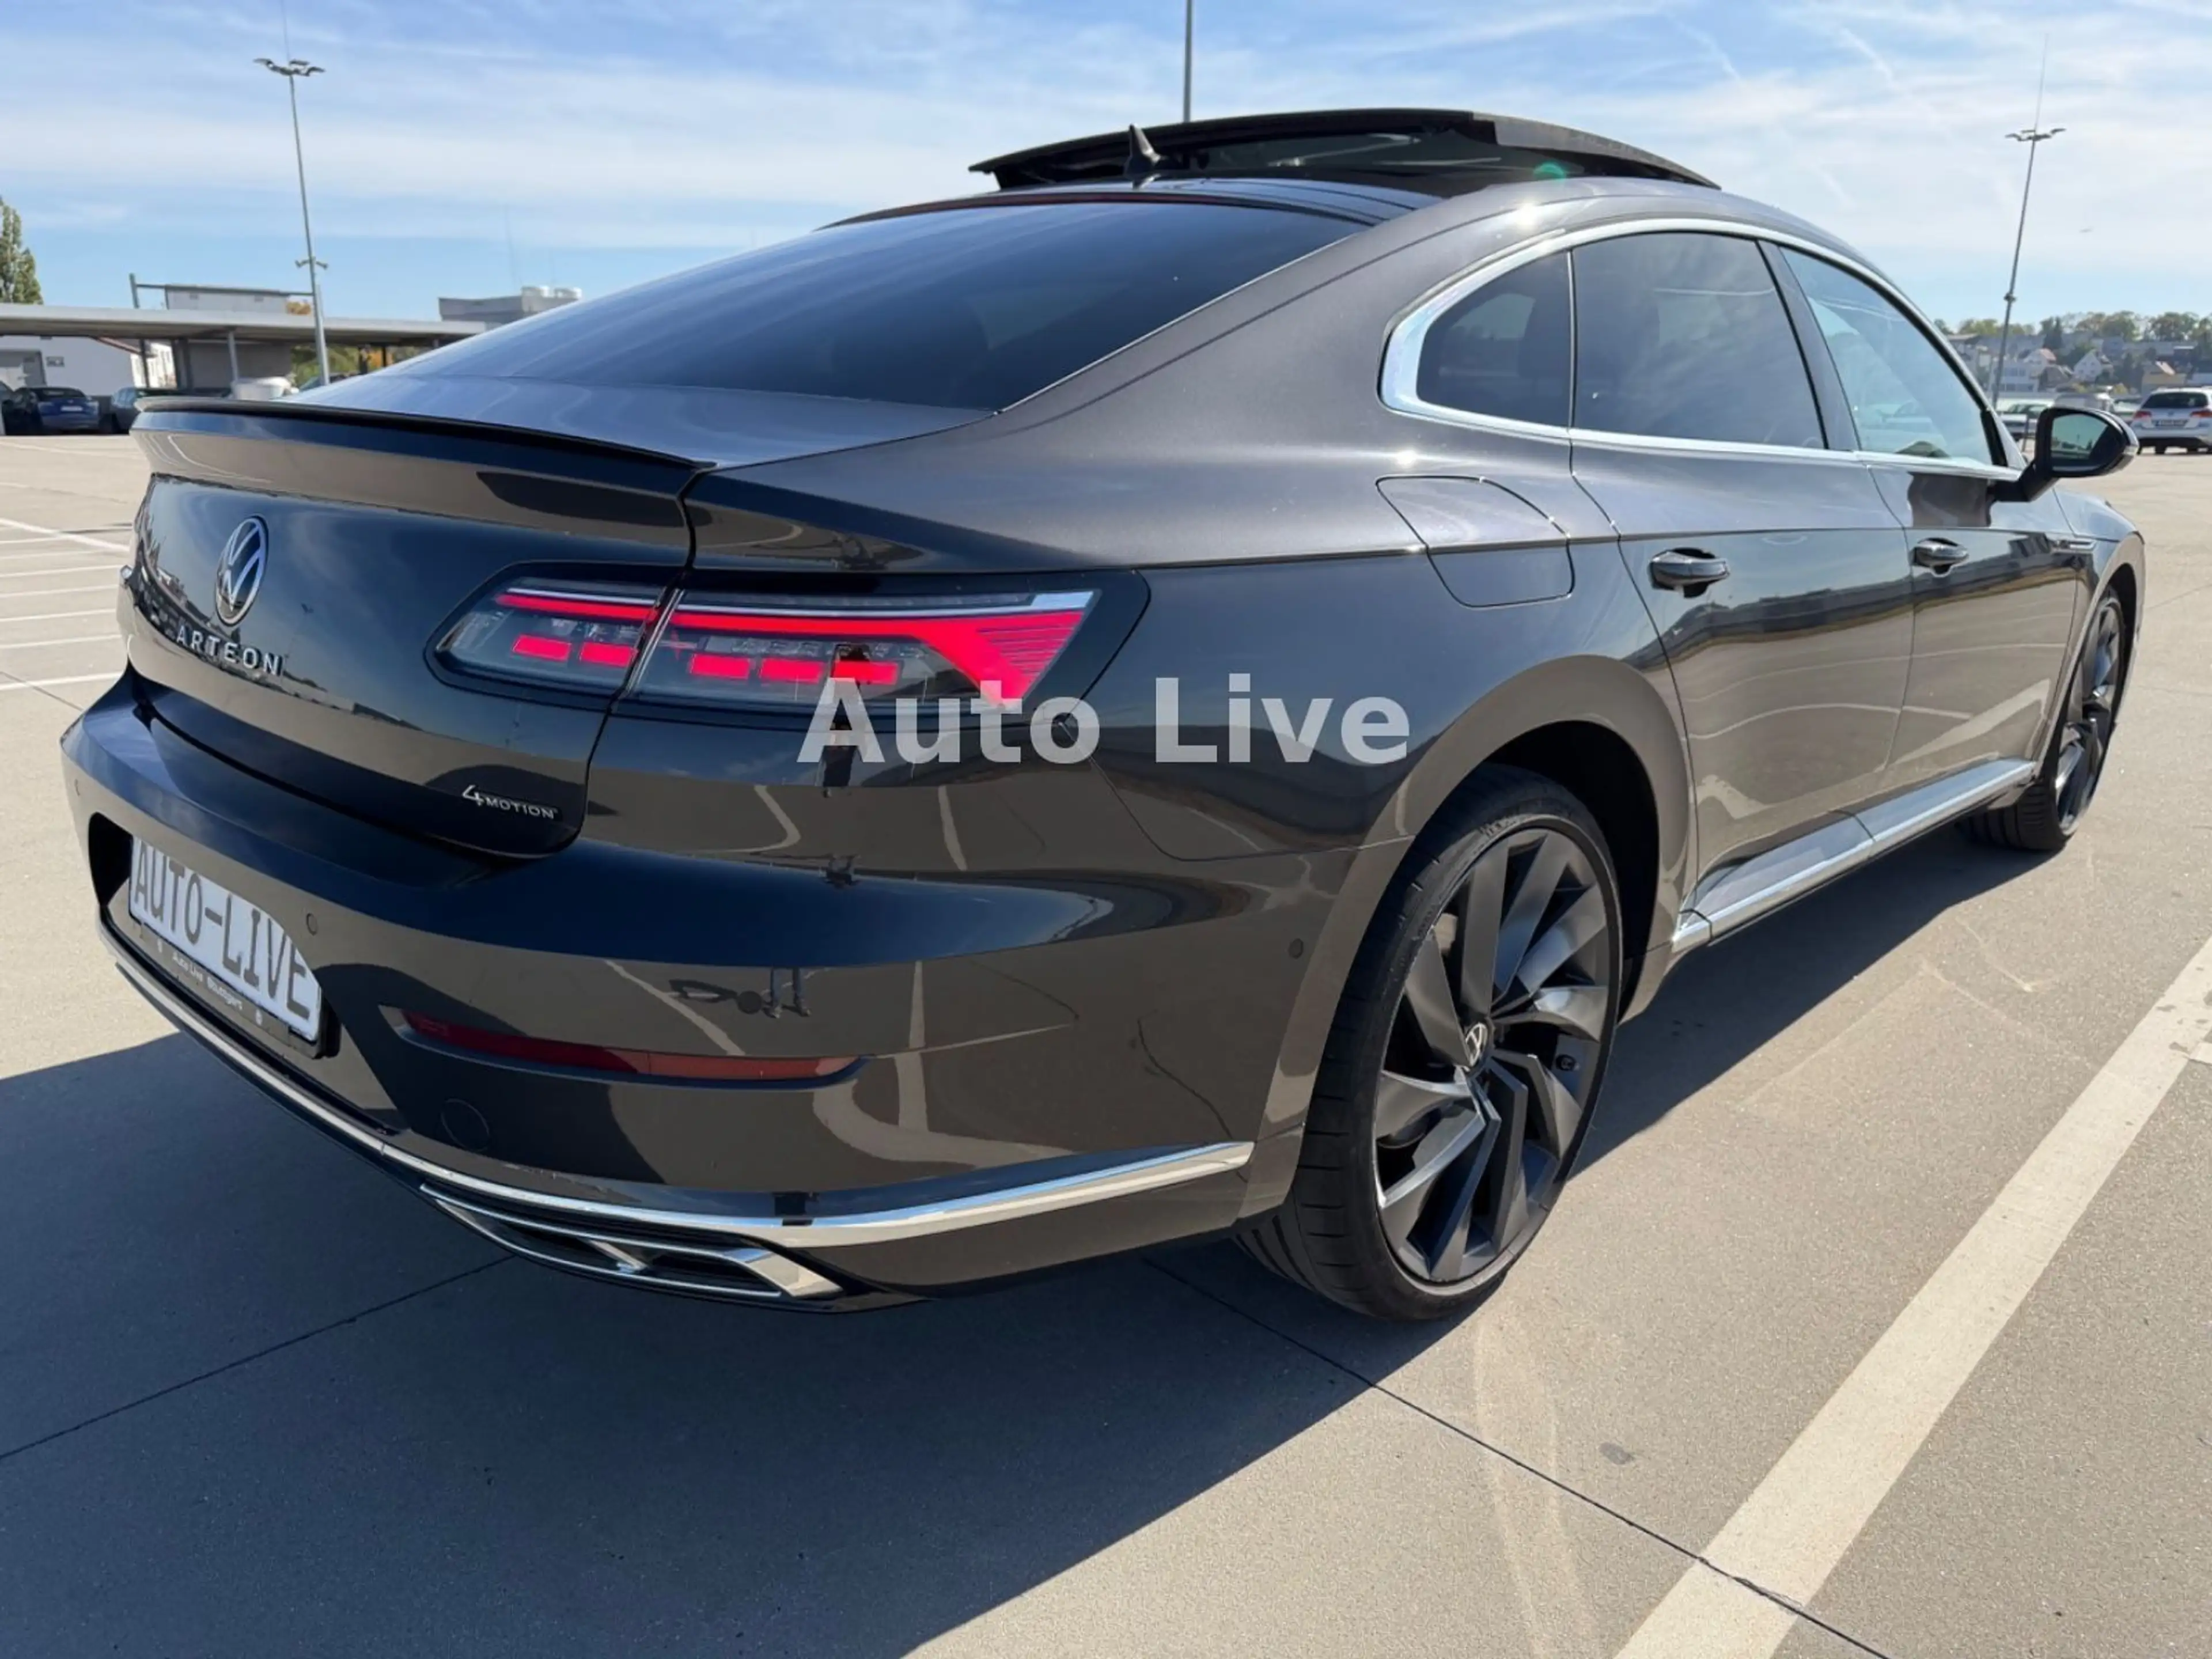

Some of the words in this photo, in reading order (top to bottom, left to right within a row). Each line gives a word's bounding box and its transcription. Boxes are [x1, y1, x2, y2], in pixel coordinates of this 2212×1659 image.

[176, 625, 279, 675] ARTEON
[462, 784, 554, 819] 4MOTION
[134, 840, 310, 1021] AUTO-LIVE
